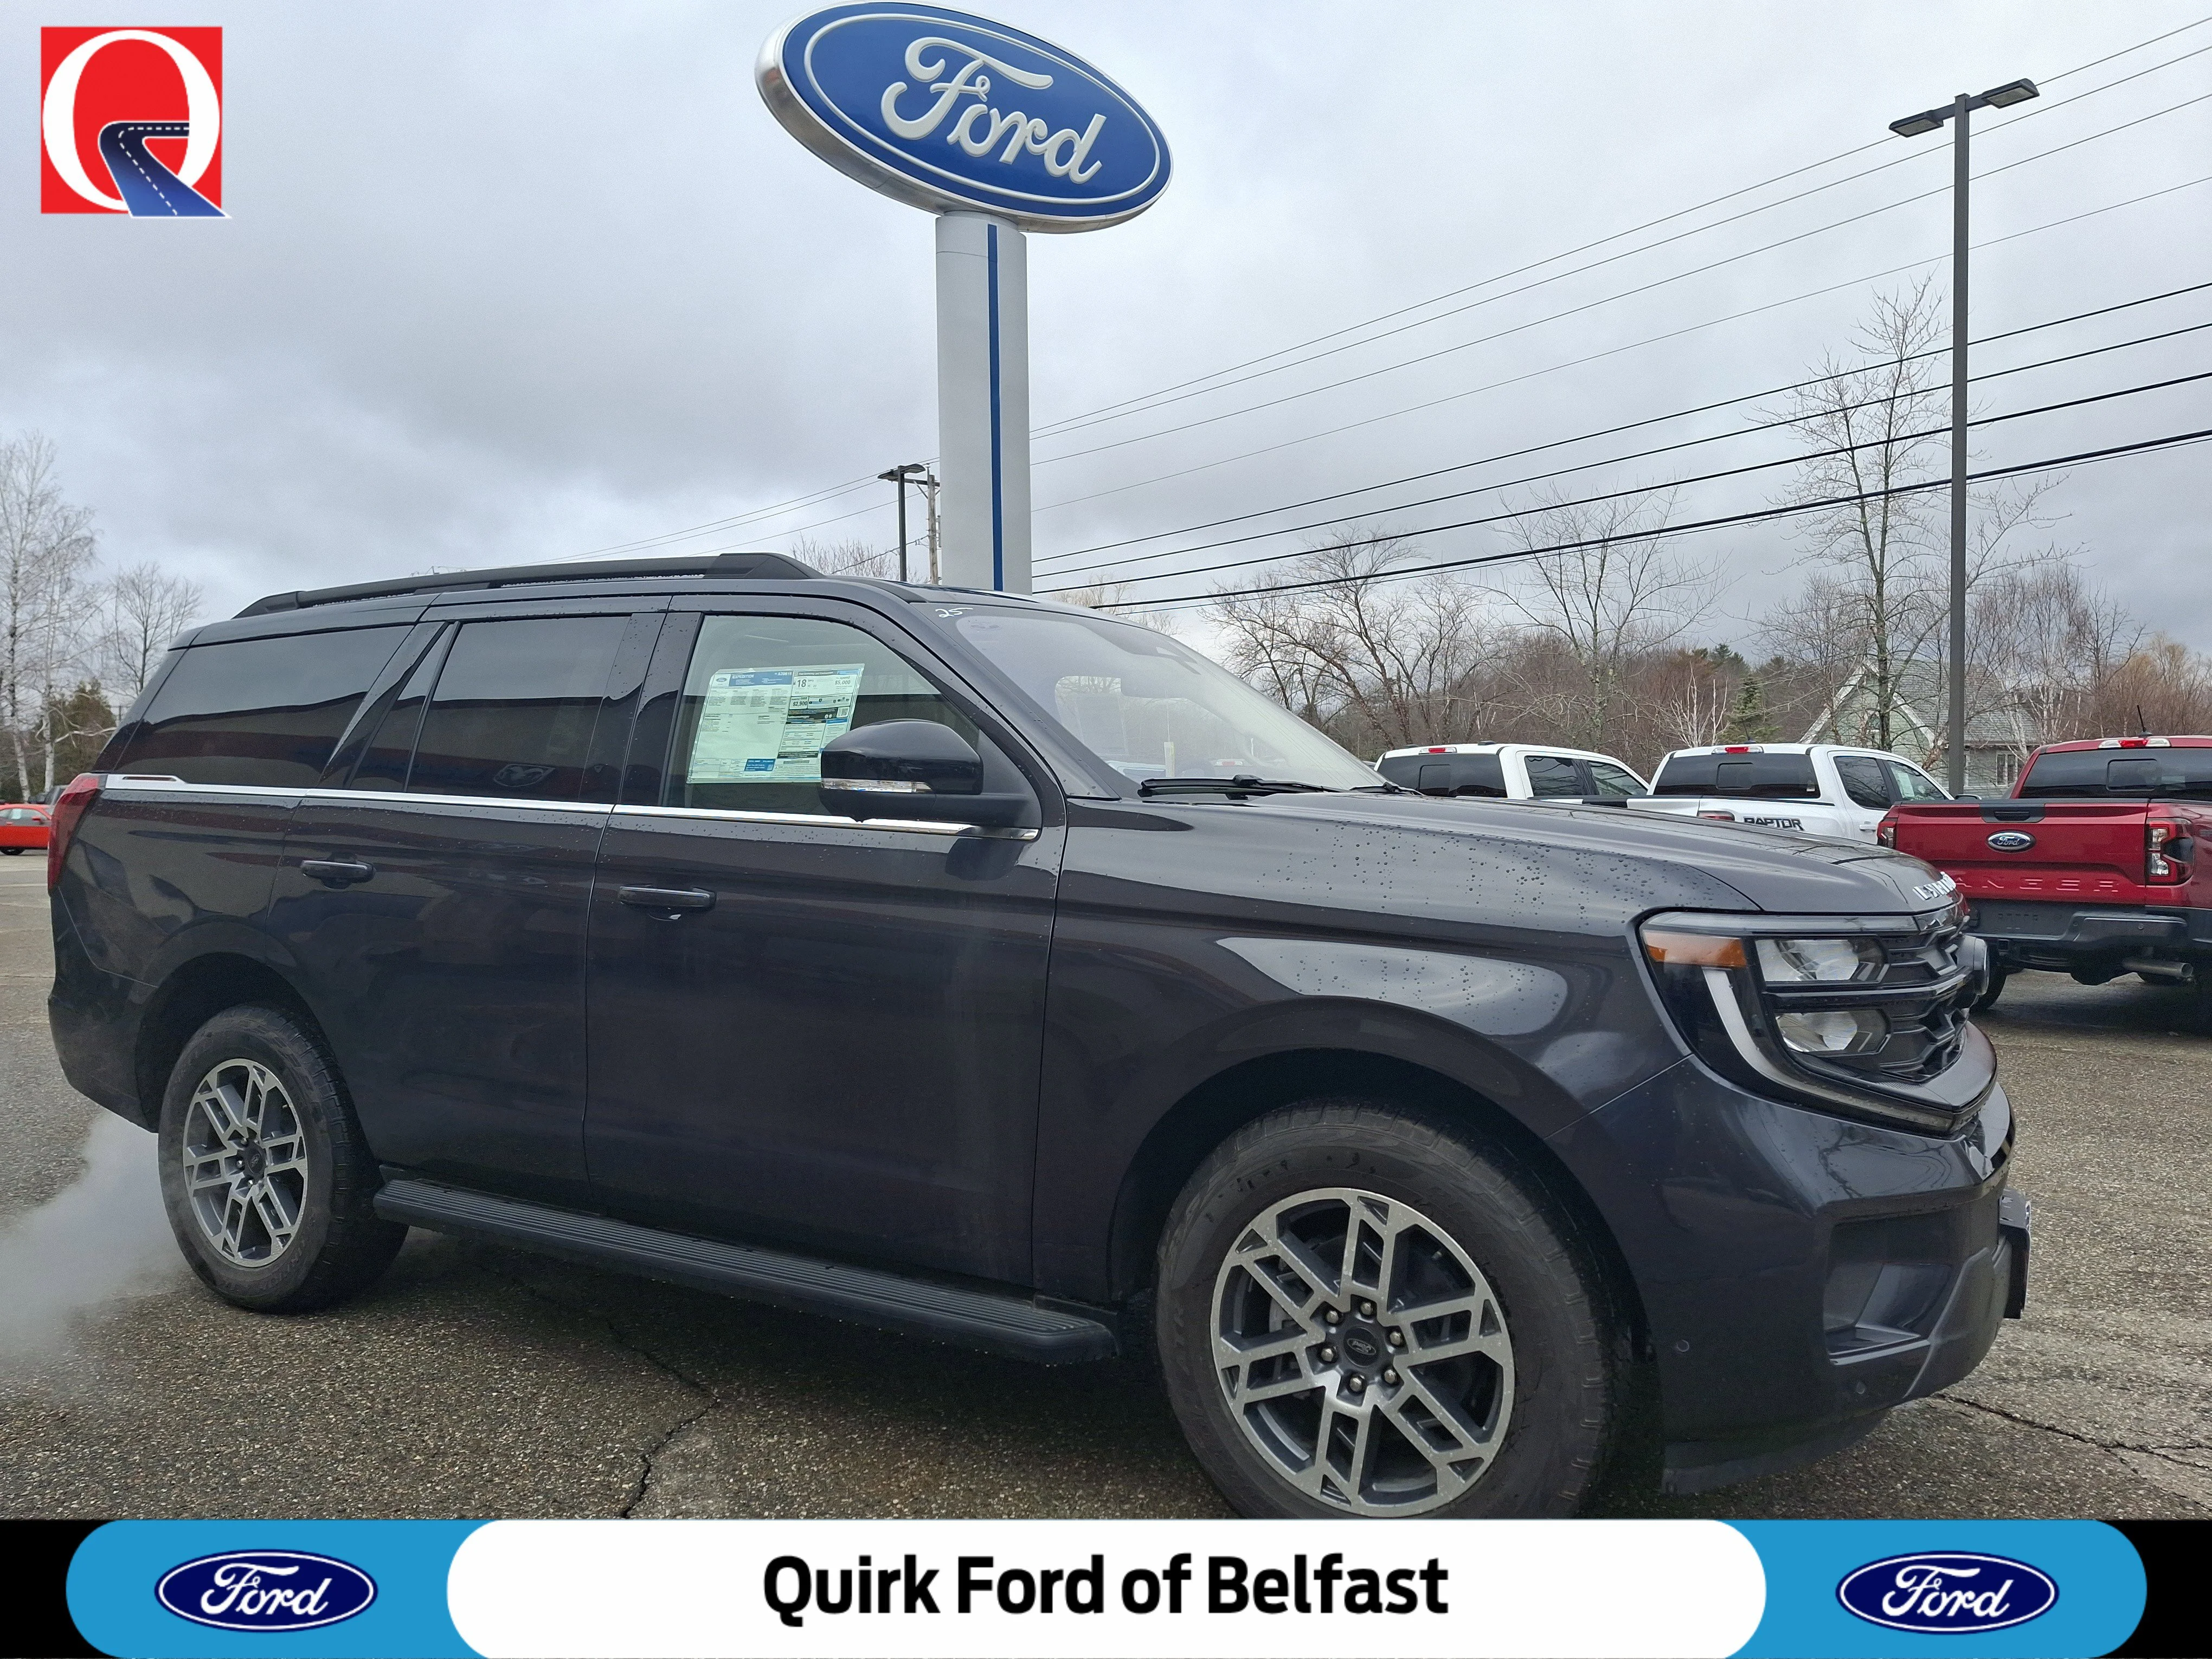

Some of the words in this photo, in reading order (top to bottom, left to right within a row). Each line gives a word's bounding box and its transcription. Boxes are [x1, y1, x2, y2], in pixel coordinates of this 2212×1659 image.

[881, 36, 1106, 184] Ford
[935, 608, 974, 618] 25
[798, 679, 807, 687] 18
[1744, 816, 1805, 831] RAPTOR
[1997, 836, 2020, 845] Ford
[1954, 877, 2119, 892] ANGER
